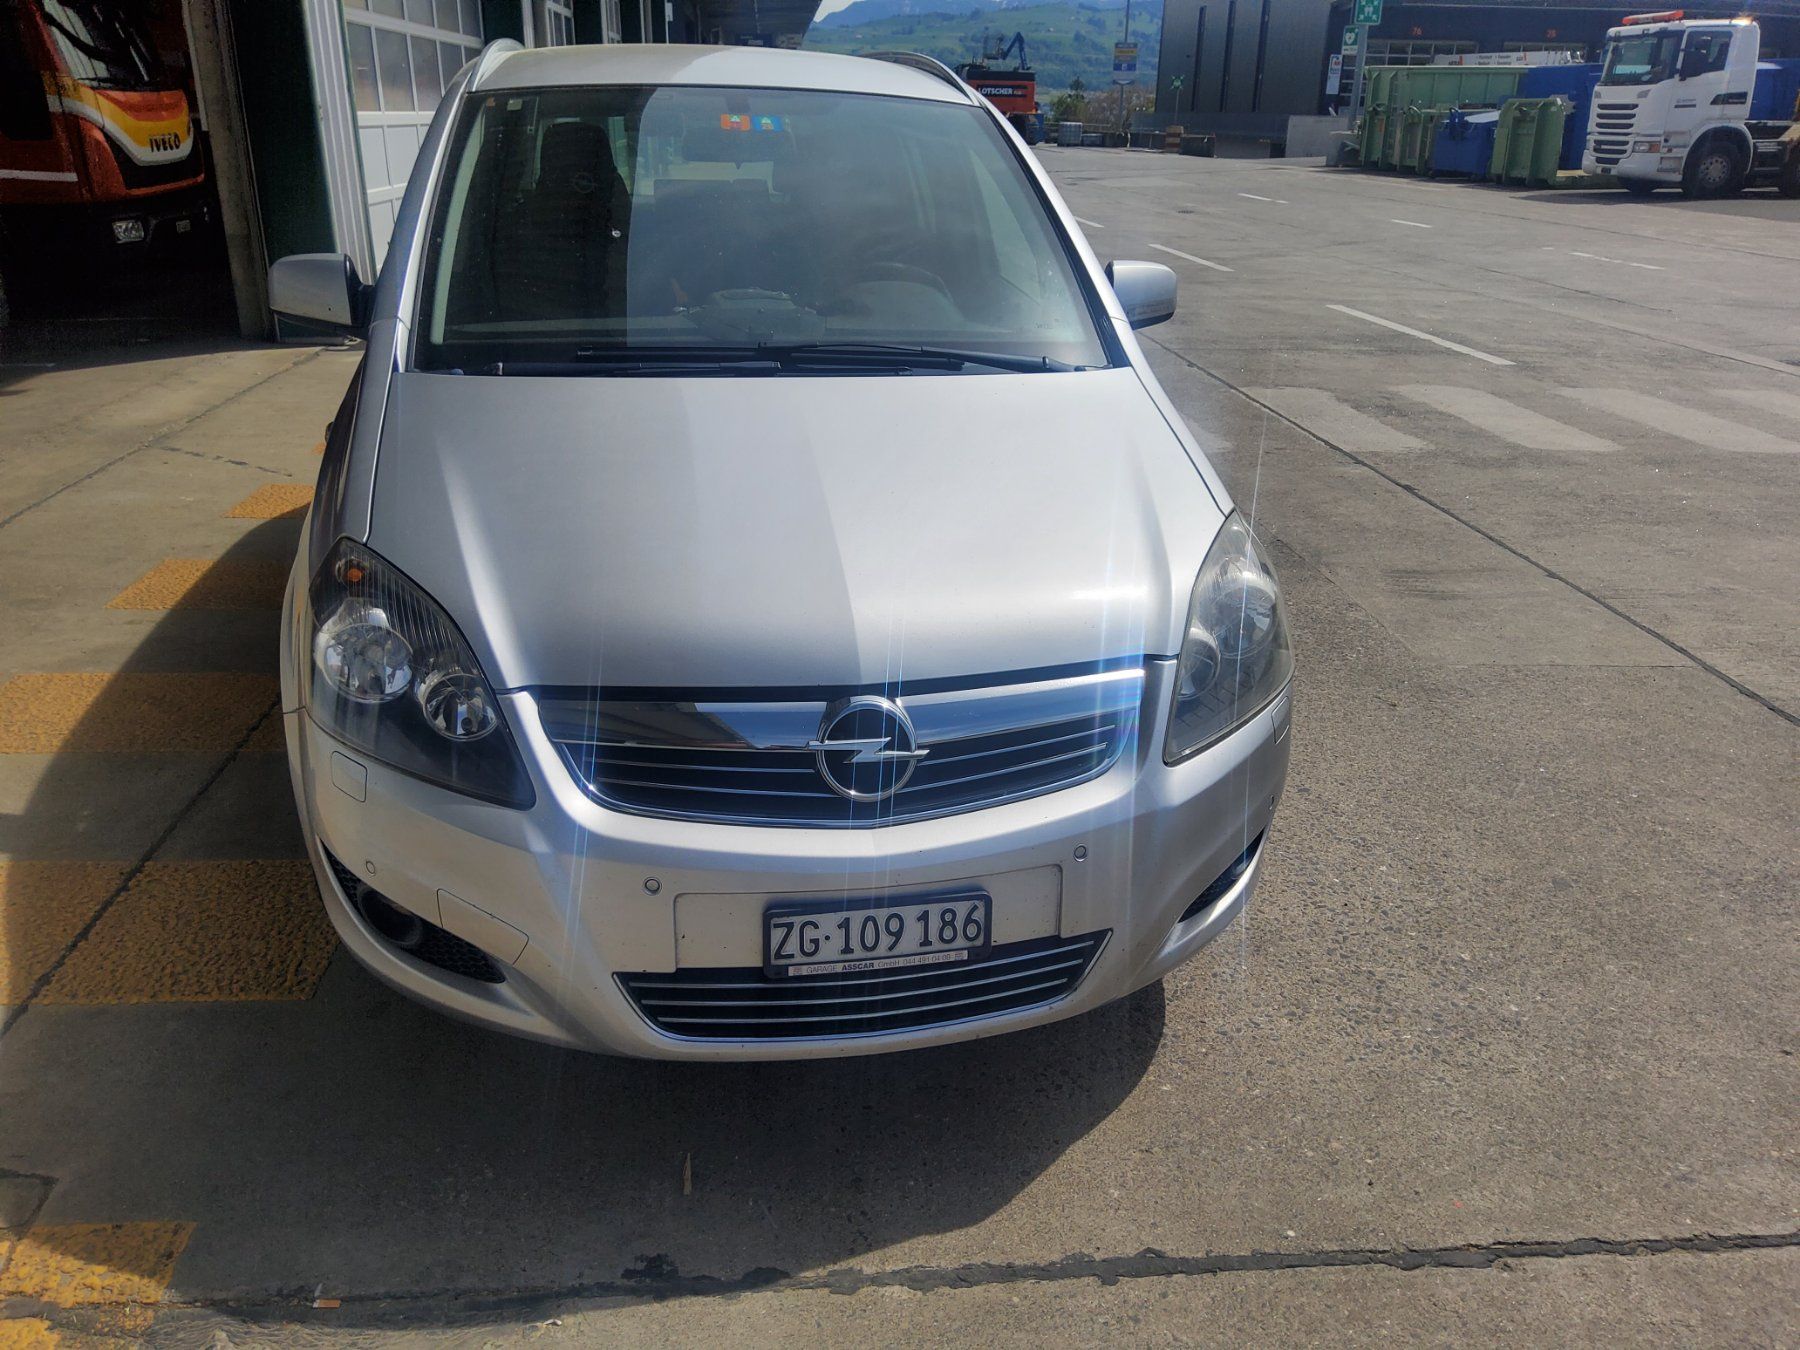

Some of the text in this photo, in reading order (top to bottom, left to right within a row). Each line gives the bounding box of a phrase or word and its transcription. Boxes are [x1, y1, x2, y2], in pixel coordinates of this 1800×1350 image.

[149, 132, 181, 152] IVECO
[916, 902, 982, 947] 186
[806, 965, 838, 974] GARAGE
[841, 962, 875, 971] ASSCAR
[877, 959, 900, 968] GmbH
